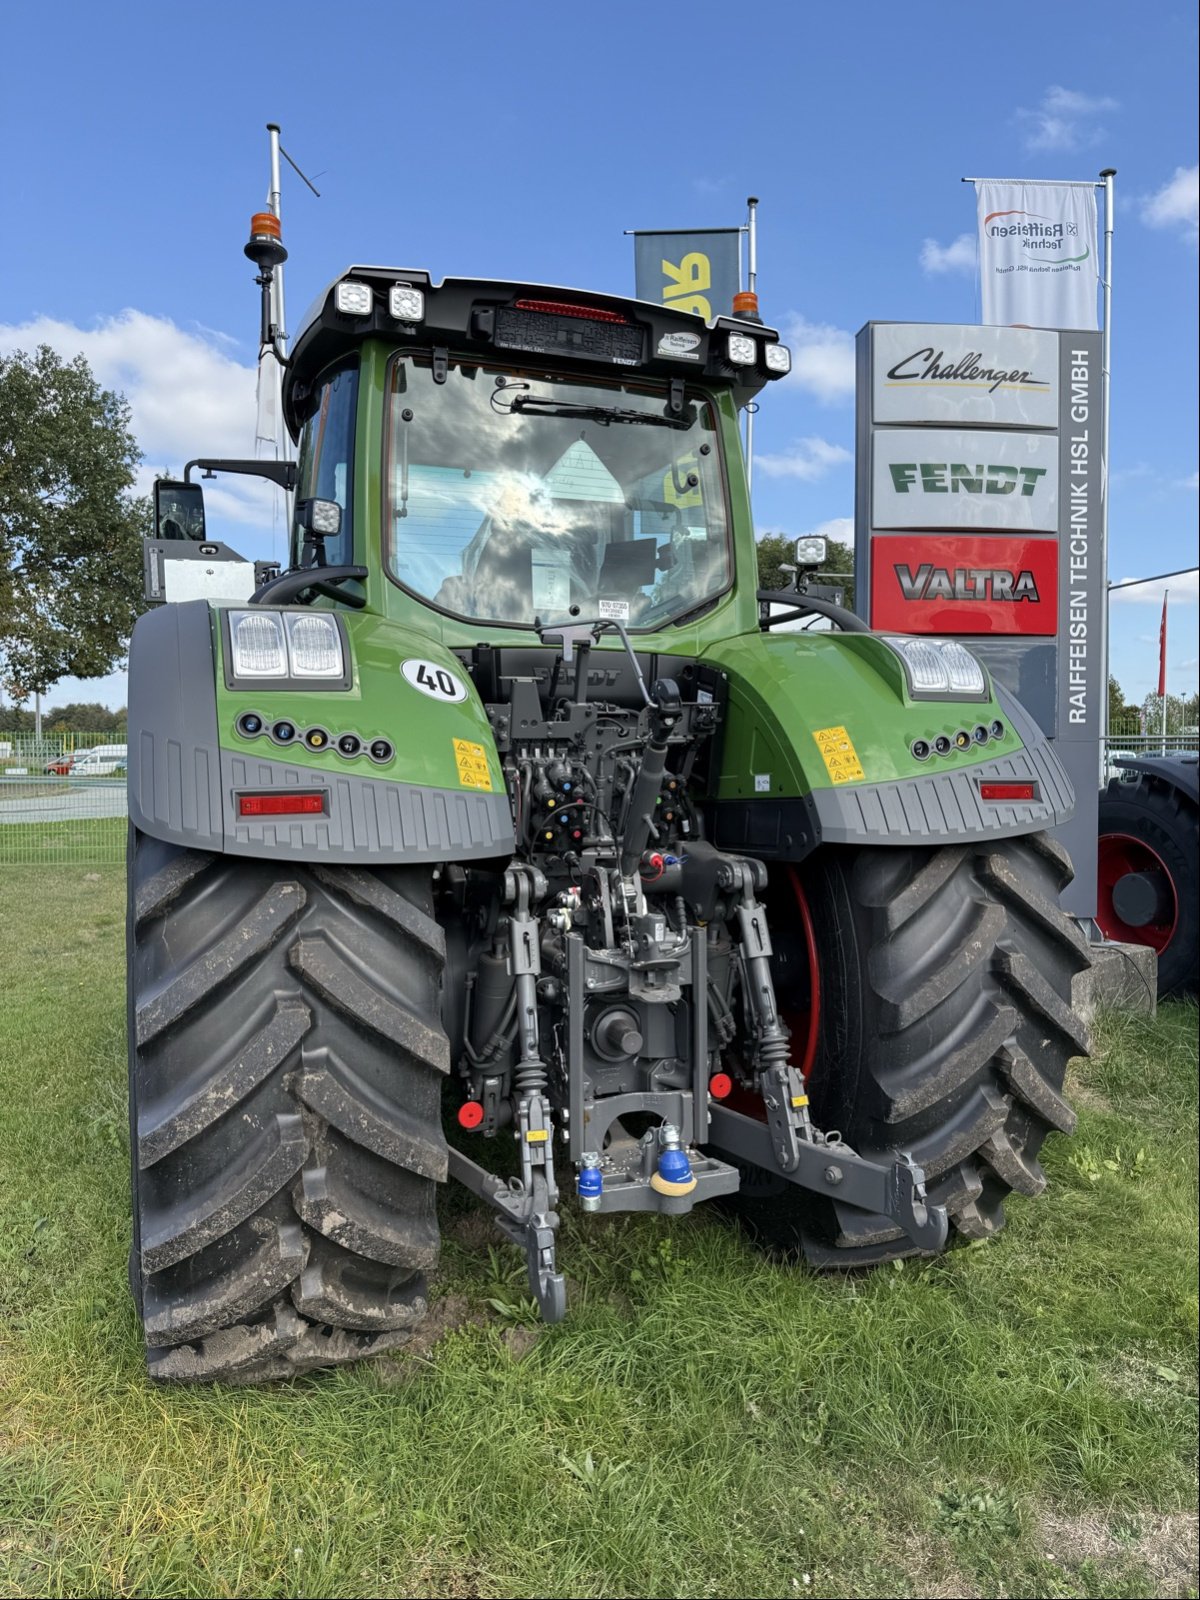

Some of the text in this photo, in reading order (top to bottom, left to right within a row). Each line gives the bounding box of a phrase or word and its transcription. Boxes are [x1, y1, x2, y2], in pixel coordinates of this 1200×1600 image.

[887, 347, 1050, 393] Challenger
[889, 463, 1047, 497] FENDT
[1069, 349, 1089, 724] RAIFFEISEN TECHNIK HSL GMBH
[893, 563, 1040, 603] VALTRA
[416, 664, 456, 697] 40
